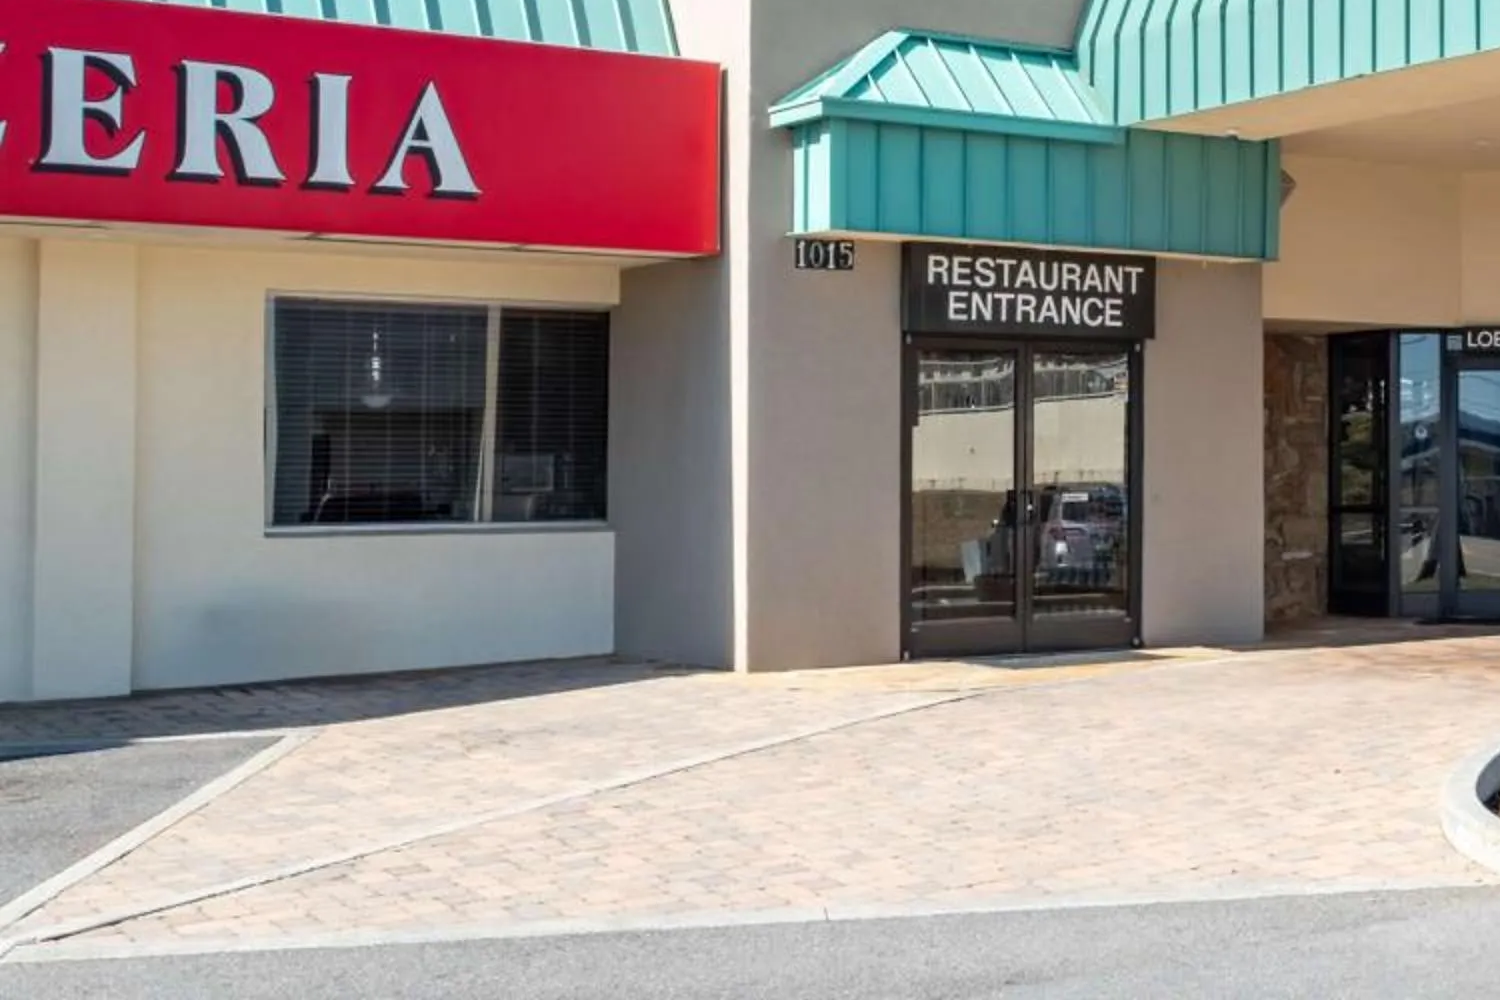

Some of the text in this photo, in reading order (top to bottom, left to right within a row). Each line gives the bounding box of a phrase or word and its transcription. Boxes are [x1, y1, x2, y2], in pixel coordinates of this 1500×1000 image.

[0, 41, 483, 199] ERIA
[796, 241, 854, 269] 1015
[927, 255, 1144, 295] RESTAURANT
[947, 291, 1123, 327] ENTRANCE
